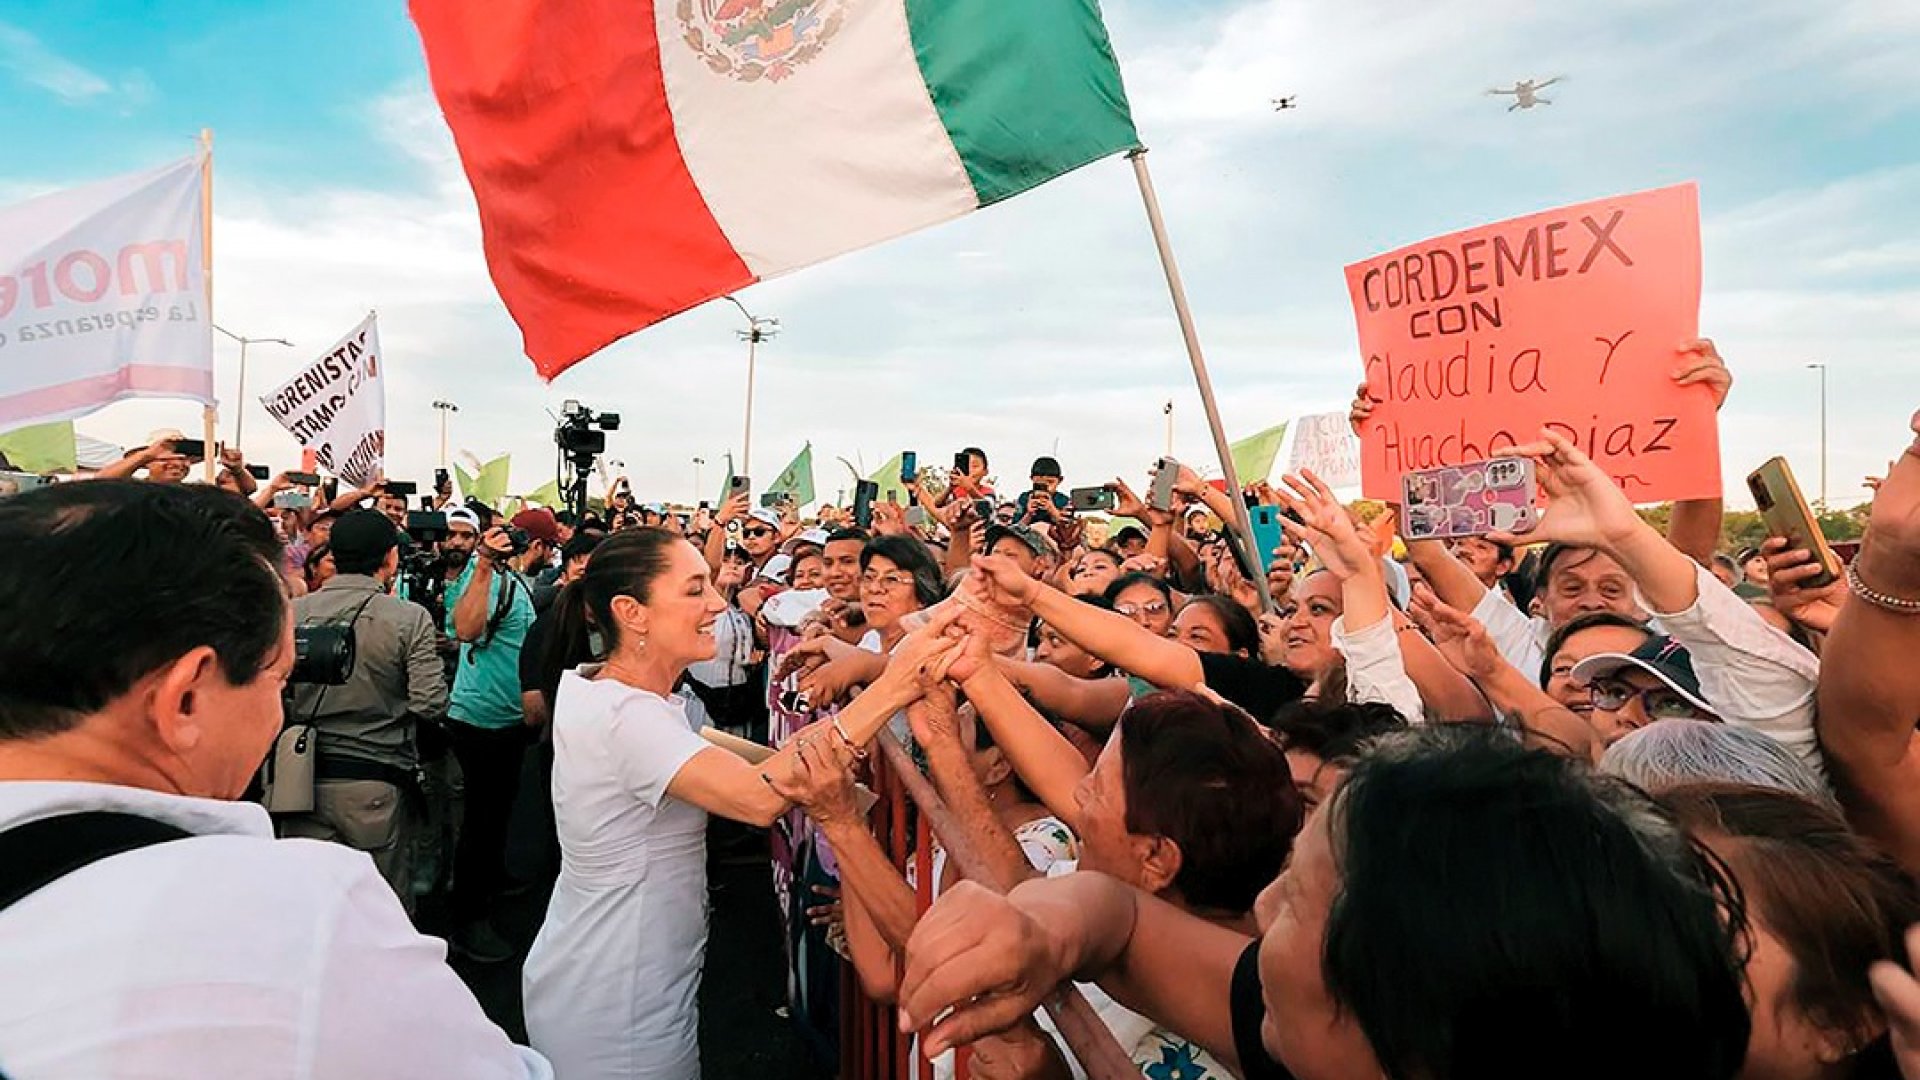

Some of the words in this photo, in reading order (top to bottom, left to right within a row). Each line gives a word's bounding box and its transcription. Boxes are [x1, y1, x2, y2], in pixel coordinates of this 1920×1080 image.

[1362, 210, 1634, 312] CORDEMEX
[1410, 297, 1503, 338] CON
[1365, 340, 1548, 404] Claudia
[1375, 418, 1519, 472] Huacho
